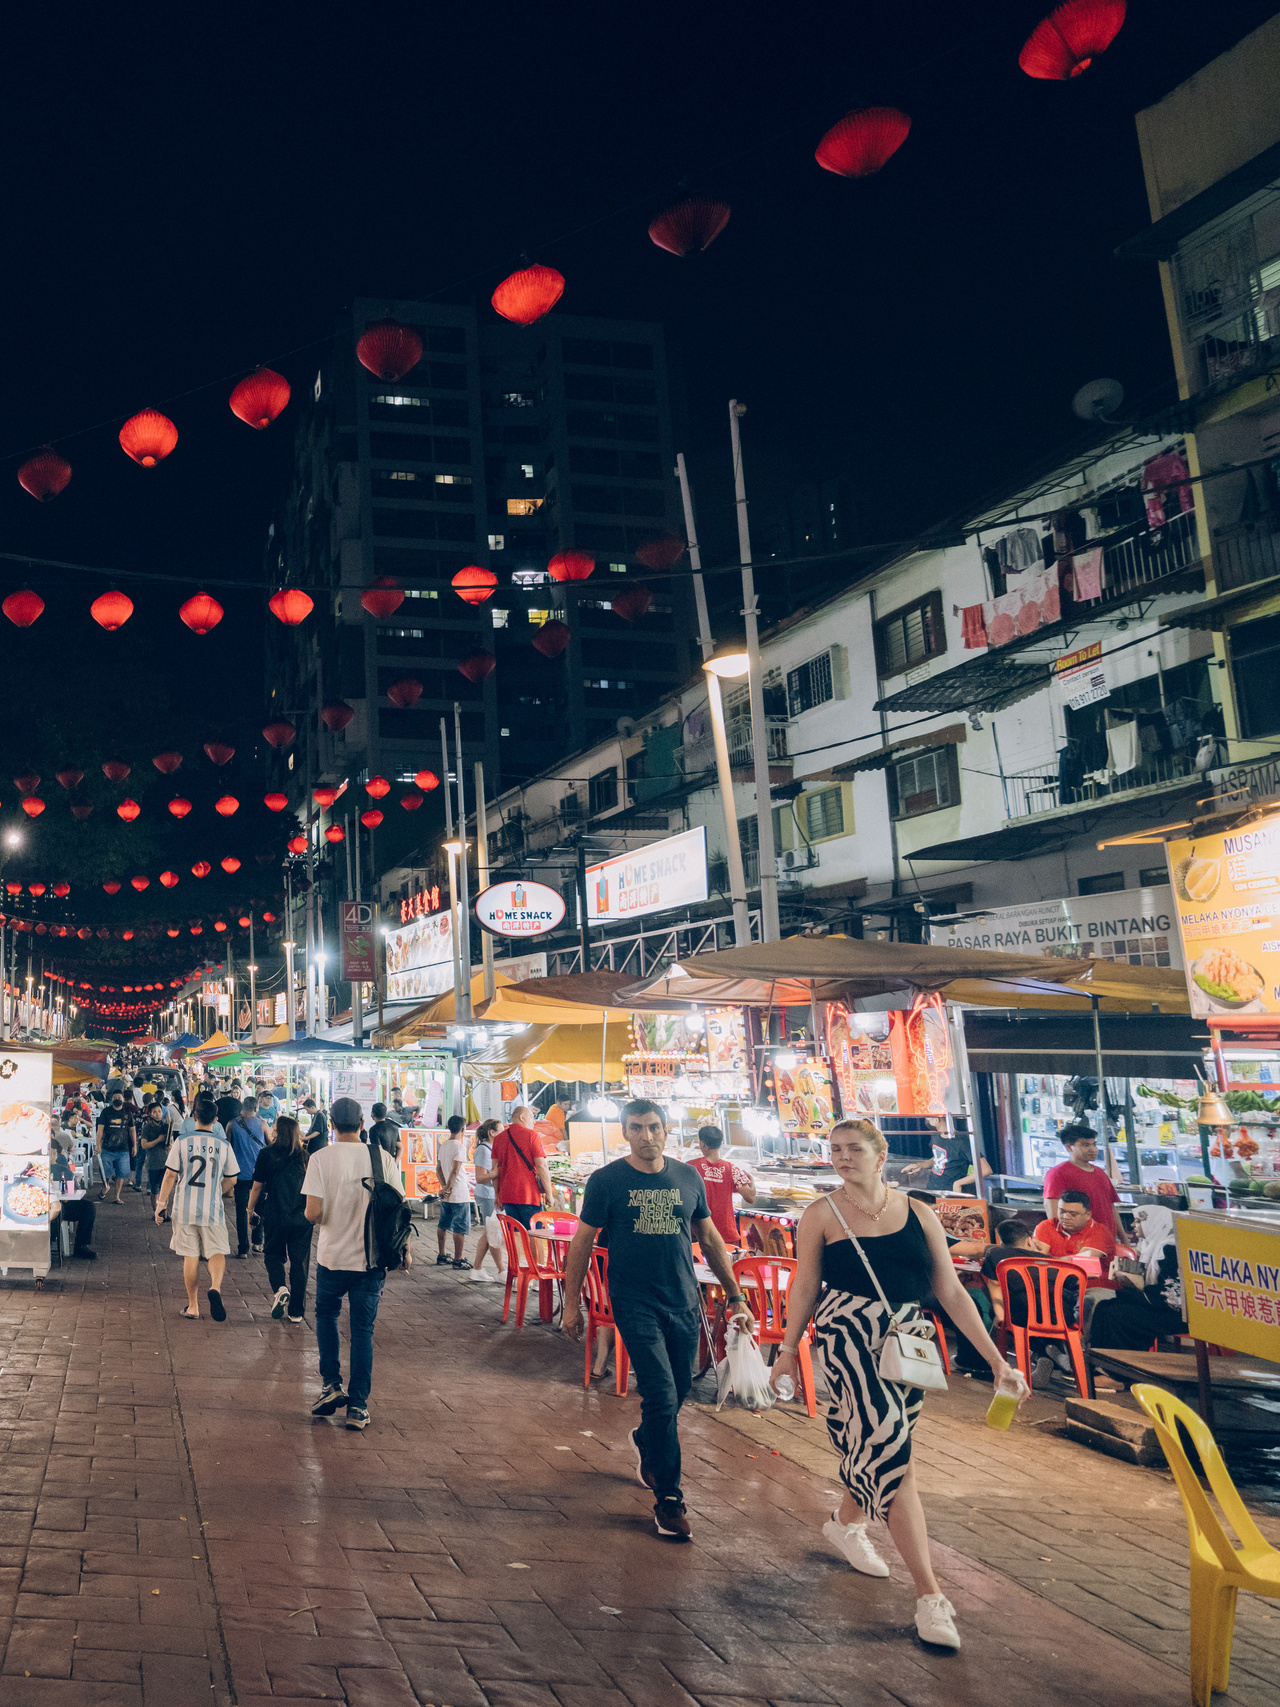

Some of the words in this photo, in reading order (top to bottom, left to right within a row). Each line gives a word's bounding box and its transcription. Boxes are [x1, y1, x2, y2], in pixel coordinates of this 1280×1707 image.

[1056, 655, 1078, 671] Room
[1079, 650, 1087, 661] To
[1088, 644, 1100, 658] Let
[1062, 674, 1081, 686] Contact
[1082, 667, 1099, 678] person
[1090, 684, 1108, 700] 2720
[1223, 829, 1277, 856] MUSAN
[618, 863, 648, 890] HOME
[650, 852, 687, 881] SNACK
[344, 904, 373, 925] 4D
[489, 909, 518, 920] HOME
[520, 911, 552, 920] SNACK
[1006, 907, 1038, 919] BARANGAN
[1038, 905, 1060, 914] RUNCIT
[1181, 912, 1219, 926] MELAKA
[1220, 905, 1262, 921] NYONYA
[1019, 919, 1038, 928] DIBUKA
[1038, 916, 1057, 926] SETIAP
[948, 934, 991, 950] PASAR
[994, 930, 1032, 947] RAYA
[1035, 923, 1082, 944] BUKIT
[1087, 914, 1171, 938] BINTANG
[204, 982, 220, 994] KK
[645, 1061, 655, 1076] &
[655, 1061, 675, 1078] BBQ
[188, 1145, 220, 1155] JASON
[187, 1155, 217, 1188] 21
[627, 1188, 683, 1207] KAPORAL
[639, 1204, 677, 1221] REBEL
[633, 1218, 683, 1235] NOMADS
[1188, 1249, 1255, 1287] MELAKA
